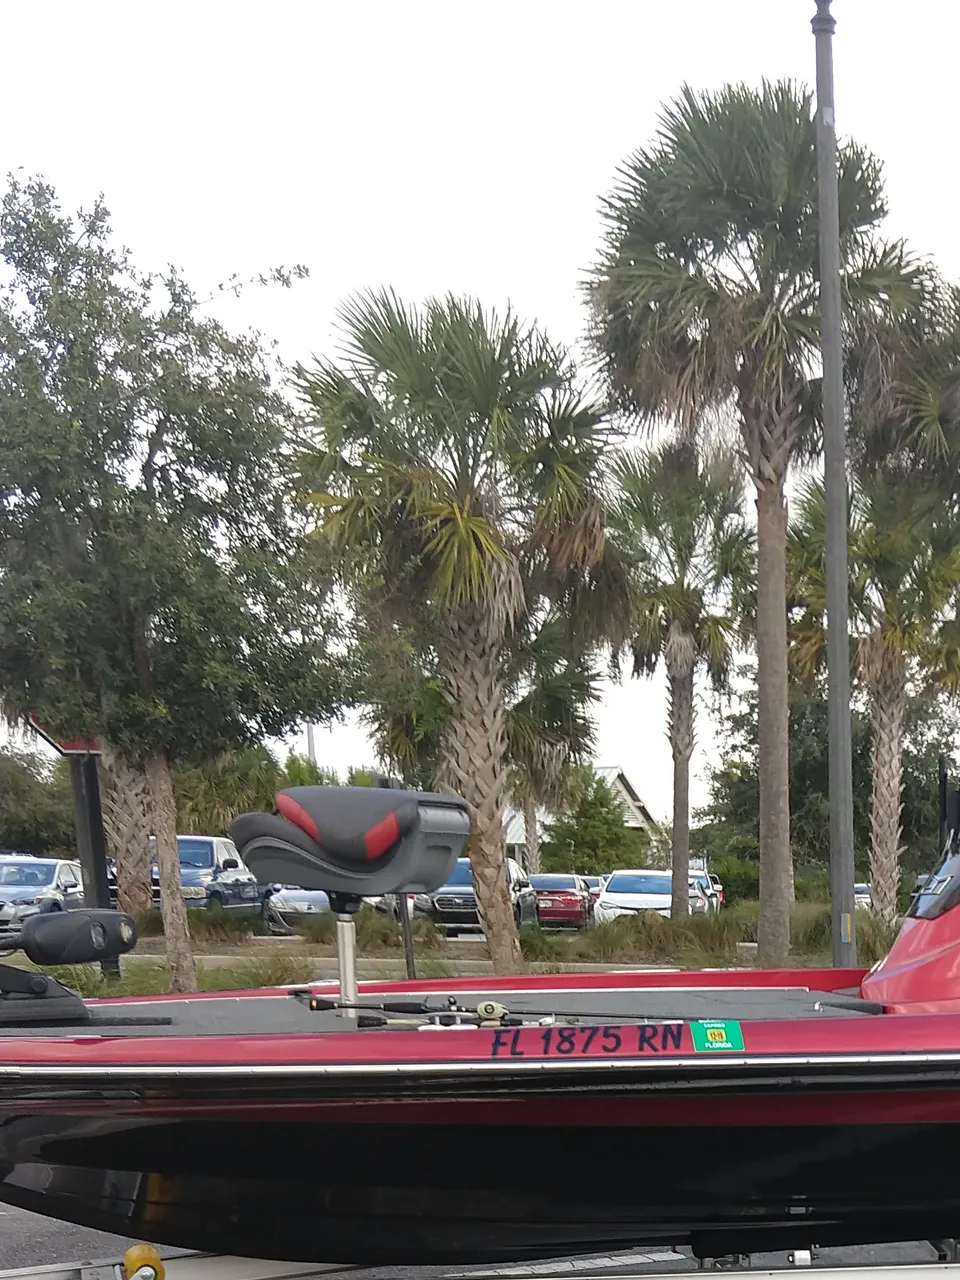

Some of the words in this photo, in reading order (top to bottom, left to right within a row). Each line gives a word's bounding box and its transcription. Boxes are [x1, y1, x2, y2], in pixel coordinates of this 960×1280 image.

[491, 1028, 525, 1056] FL
[541, 1024, 622, 1055] 1875
[637, 1023, 685, 1053] RN
